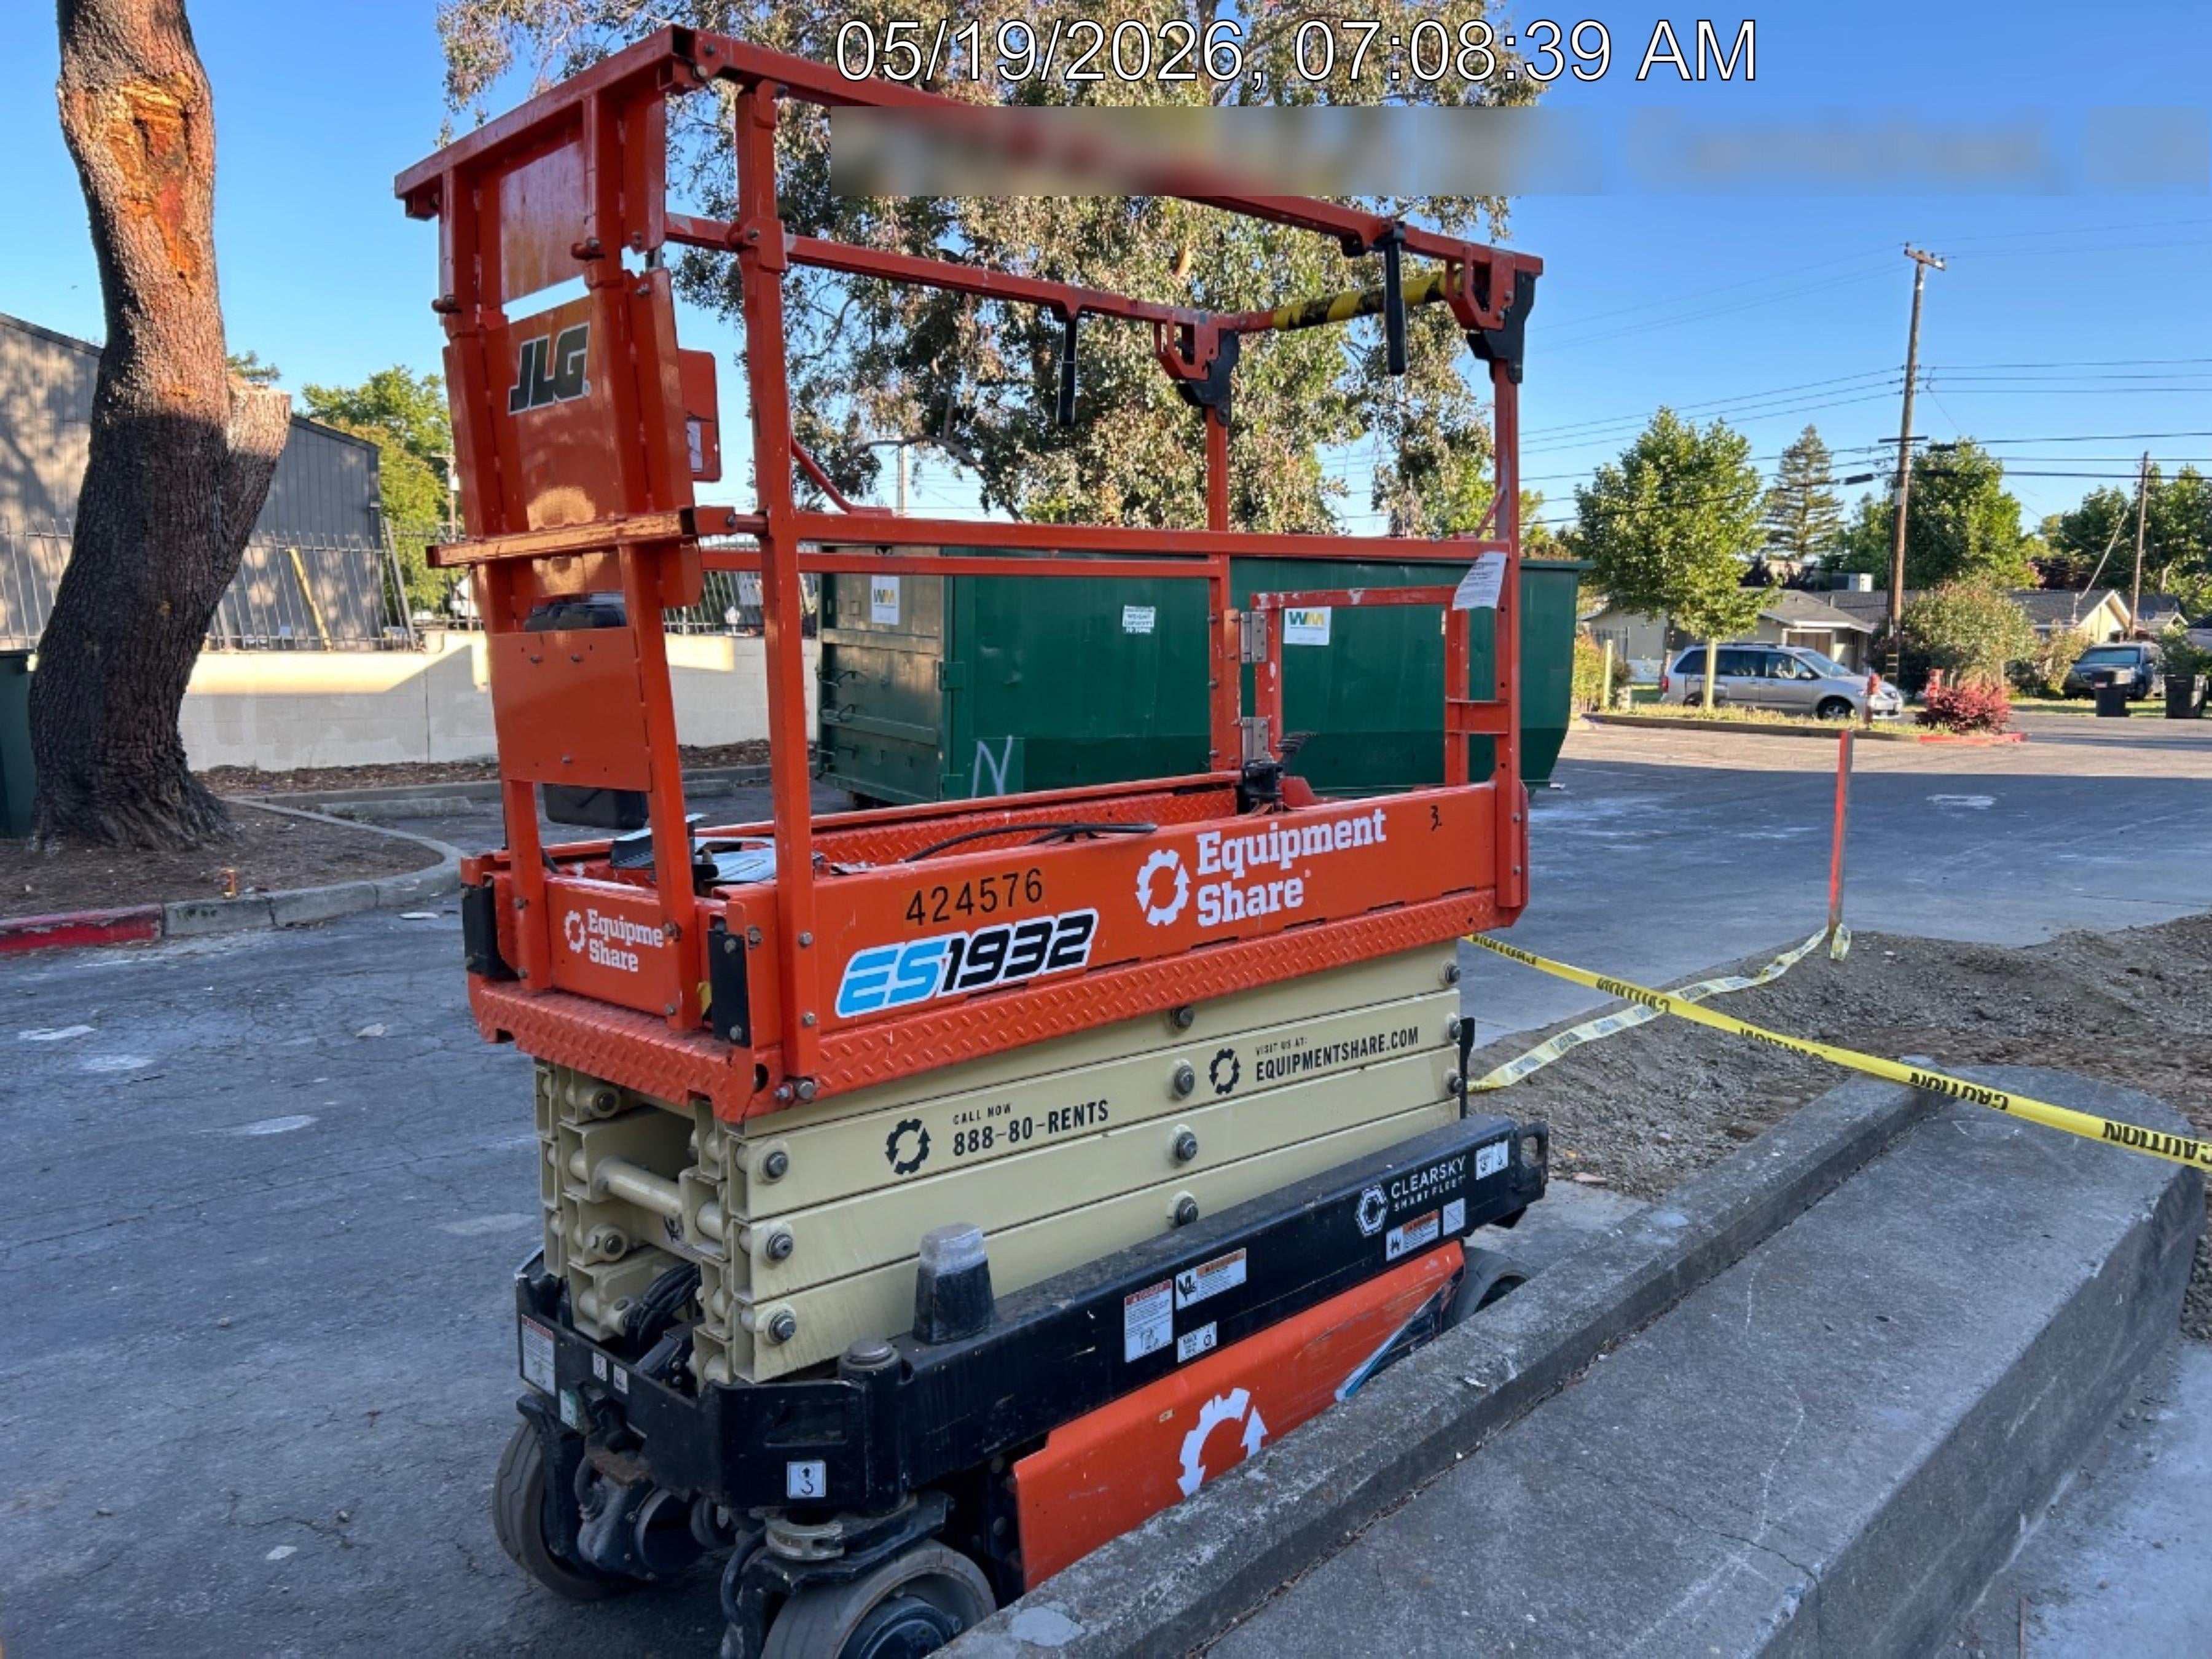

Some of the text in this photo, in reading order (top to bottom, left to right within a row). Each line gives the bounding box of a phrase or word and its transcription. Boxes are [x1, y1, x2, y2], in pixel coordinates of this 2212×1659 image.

[508, 321, 590, 416] JLG
[1288, 611, 1325, 626] WM
[1196, 808, 1387, 879] Equipment
[906, 868, 1044, 926] 424576
[1197, 876, 1304, 927] Share
[586, 908, 664, 948] Equipme
[589, 938, 639, 973] Share
[835, 908, 1099, 1018] ES1932
[1257, 1026, 1419, 1082] EQUIPMENTSHARE.COM
[952, 1099, 1110, 1156] 888-80-RENTS
[953, 1104, 1012, 1125] CALL NOW
[1391, 1155, 1466, 1199] CLEARSKY
